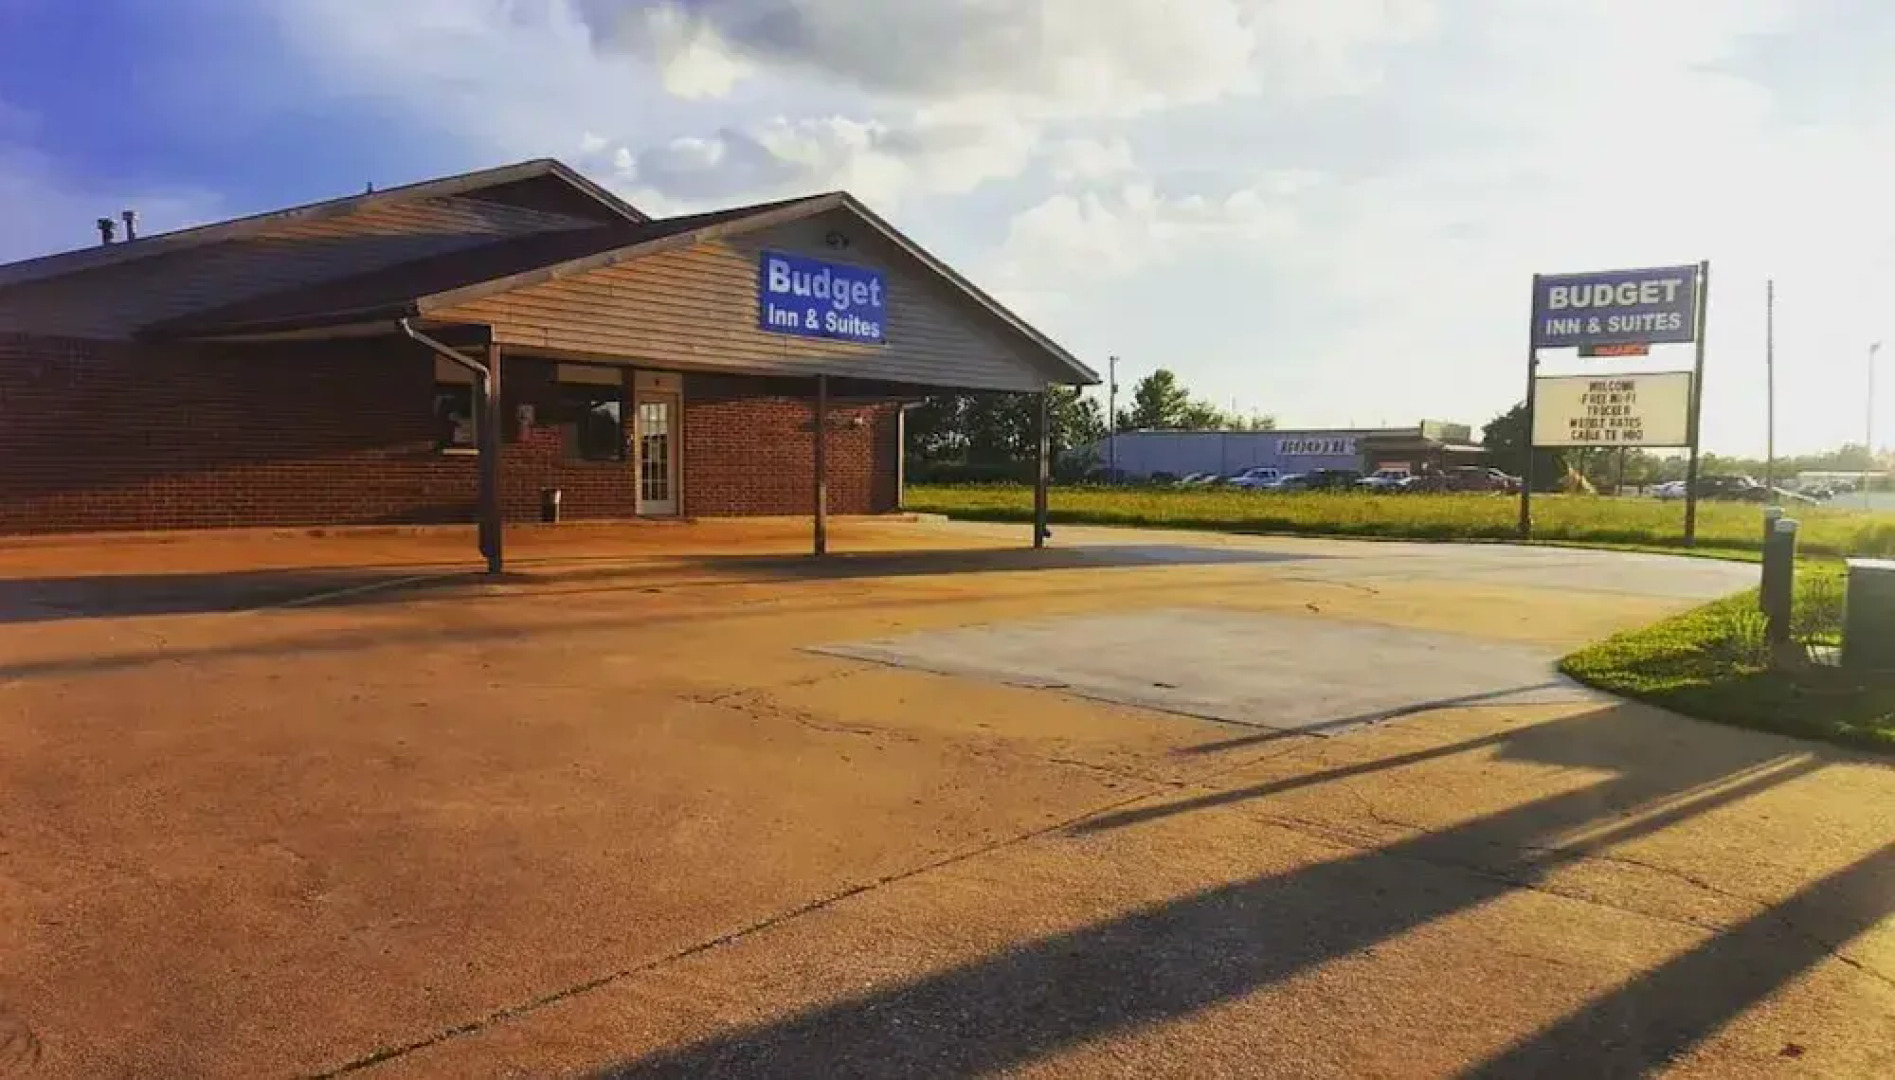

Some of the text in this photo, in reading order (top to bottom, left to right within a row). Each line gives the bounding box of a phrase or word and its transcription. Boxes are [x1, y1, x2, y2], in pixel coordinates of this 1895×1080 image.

[768, 259, 881, 310] Budget
[1549, 279, 1683, 309] BUDGET
[768, 303, 880, 338] Inn & Suites
[1546, 312, 1682, 335] INN & SUITES
[1589, 381, 1634, 392] WELCOME
